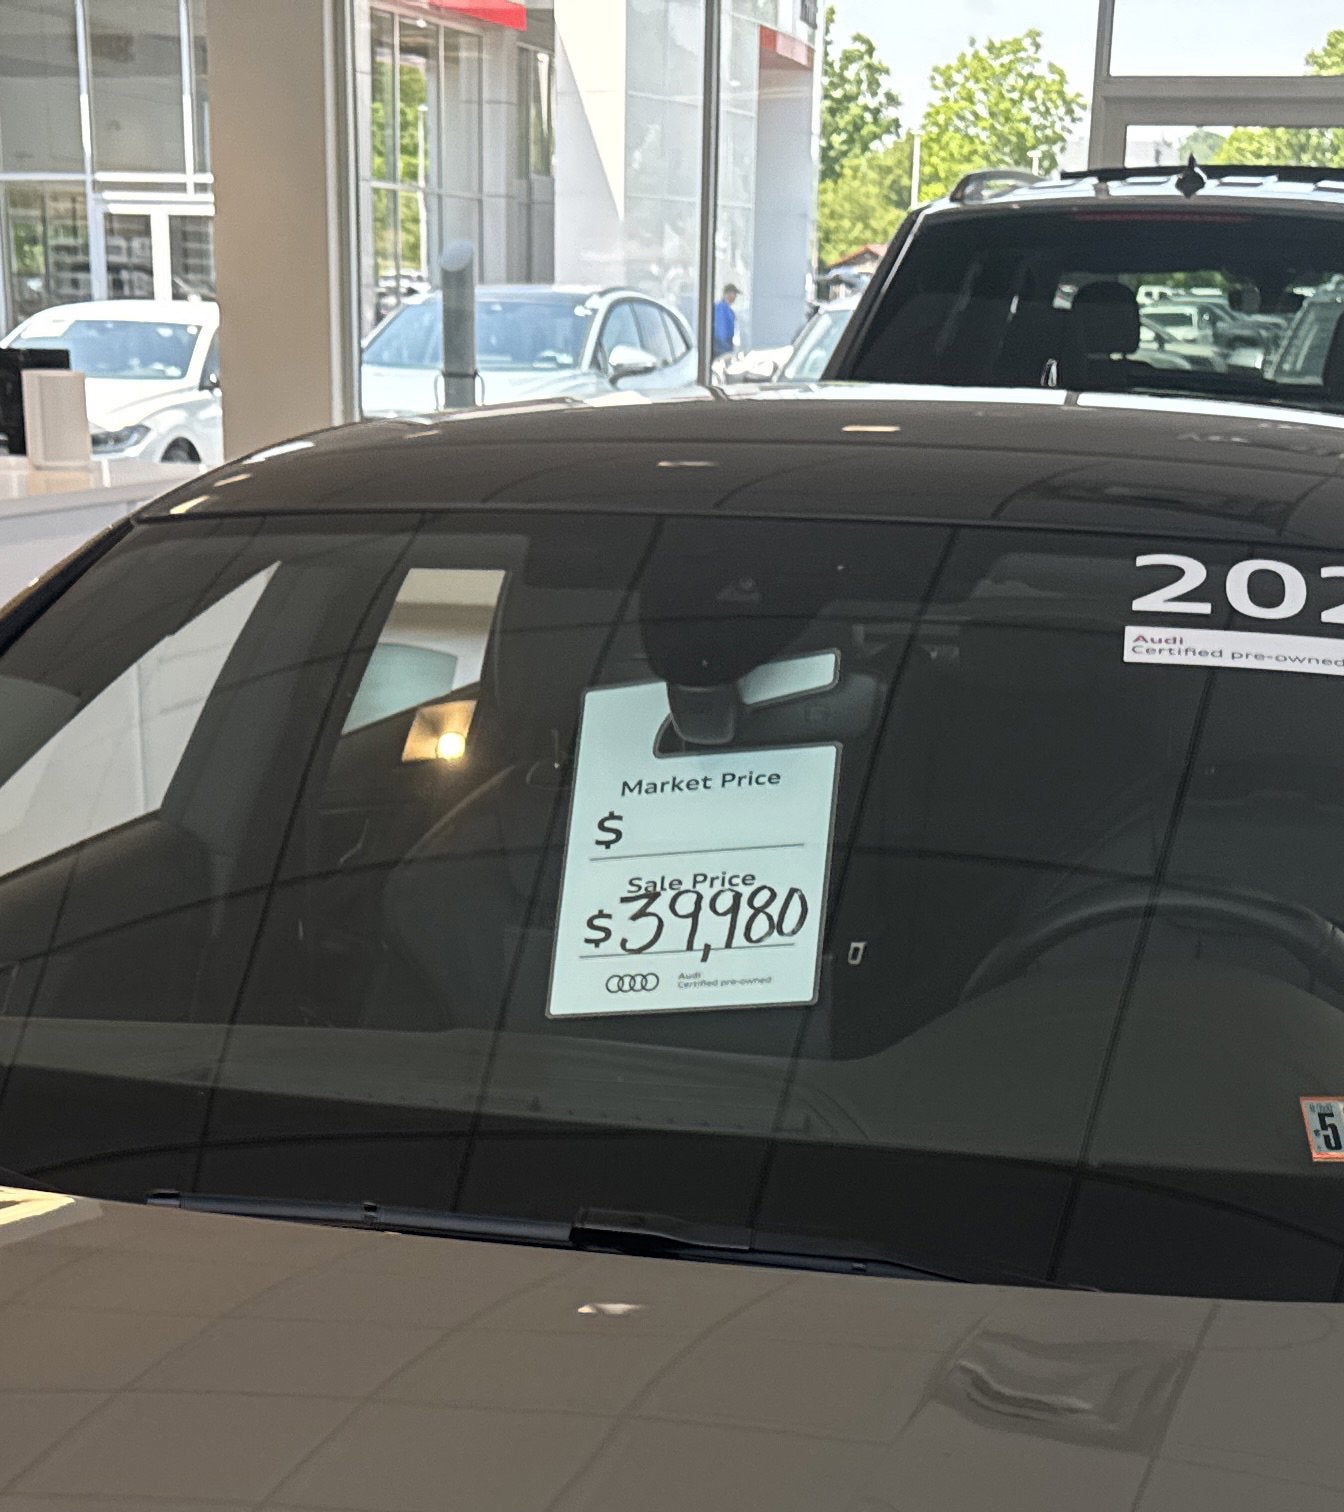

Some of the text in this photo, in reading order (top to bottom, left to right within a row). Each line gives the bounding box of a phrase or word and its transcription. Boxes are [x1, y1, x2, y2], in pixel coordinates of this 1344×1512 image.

[1131, 645, 1224, 658] Certified
[1133, 634, 1184, 645] Audi
[620, 770, 781, 797] Market Price
[594, 811, 624, 849] $
[626, 871, 756, 894] Sale Price
[1317, 1112, 1343, 1150] 5
